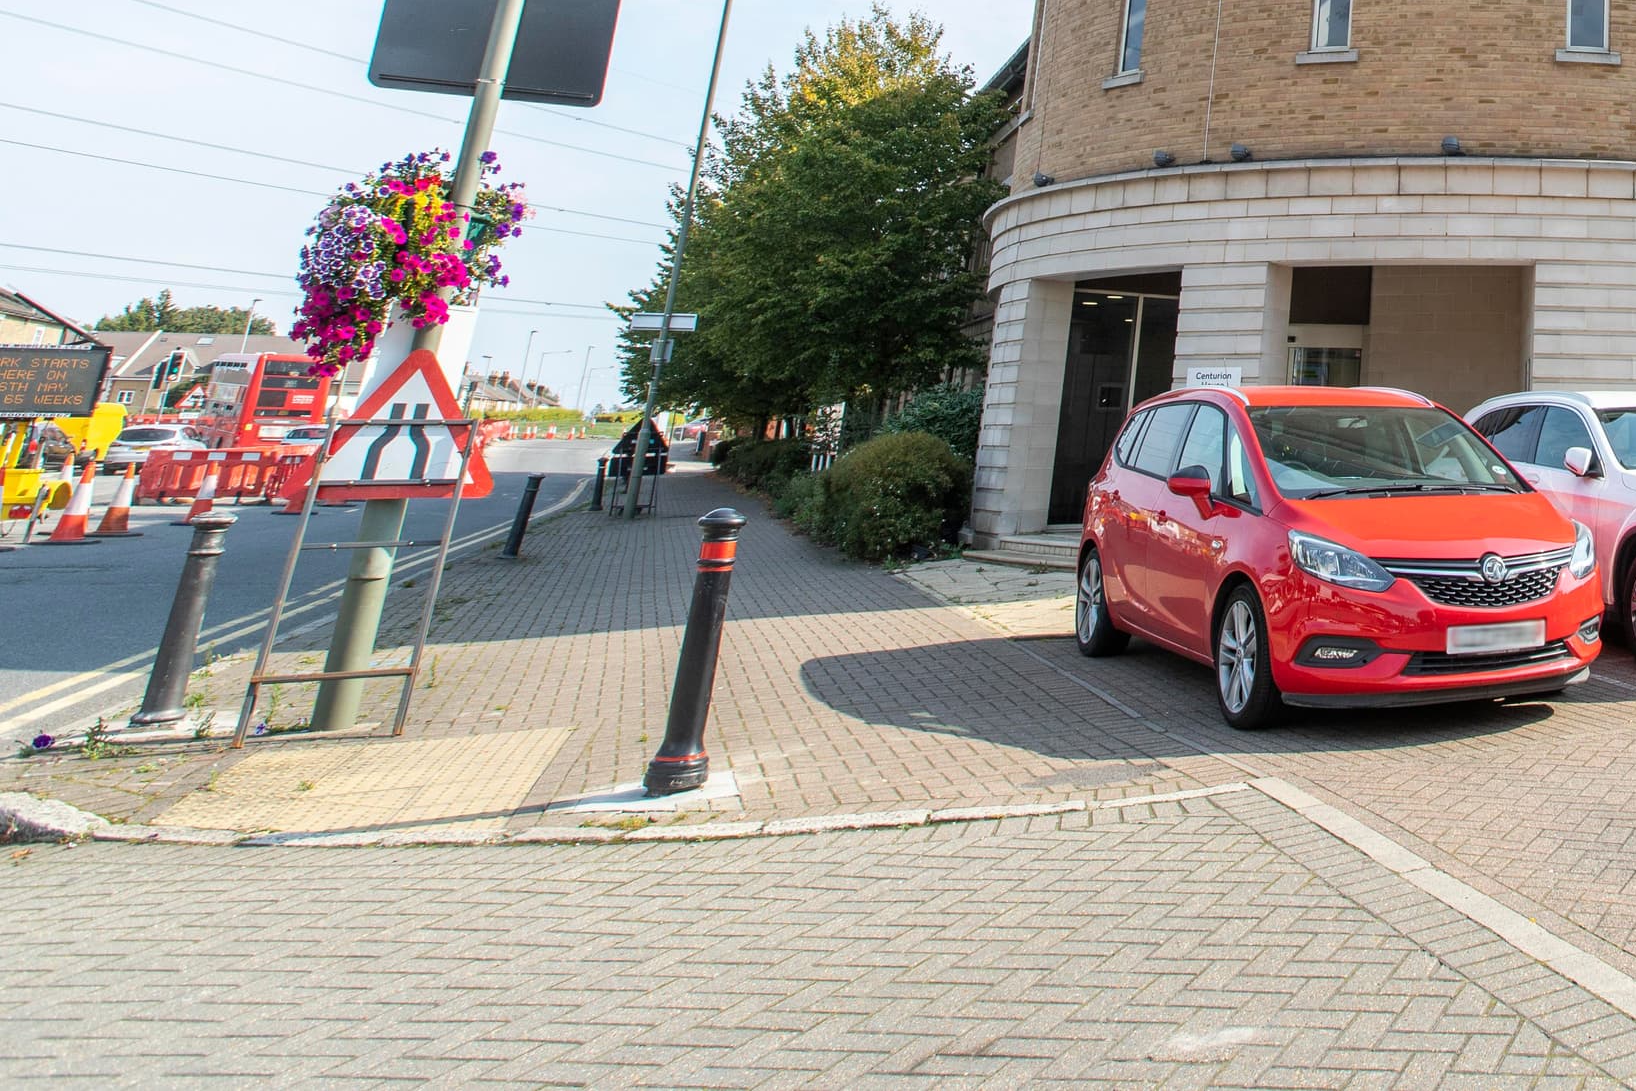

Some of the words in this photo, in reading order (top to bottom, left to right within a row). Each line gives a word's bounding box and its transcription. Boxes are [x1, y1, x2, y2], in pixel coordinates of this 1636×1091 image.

[0, 357, 22, 367] RK
[31, 357, 90, 369] STARTS
[46, 370, 68, 381] ON
[1195, 372, 1232, 380] Centurion
[37, 382, 69, 392] MAY
[3, 394, 25, 405] 65
[34, 394, 84, 405] WEEKS
